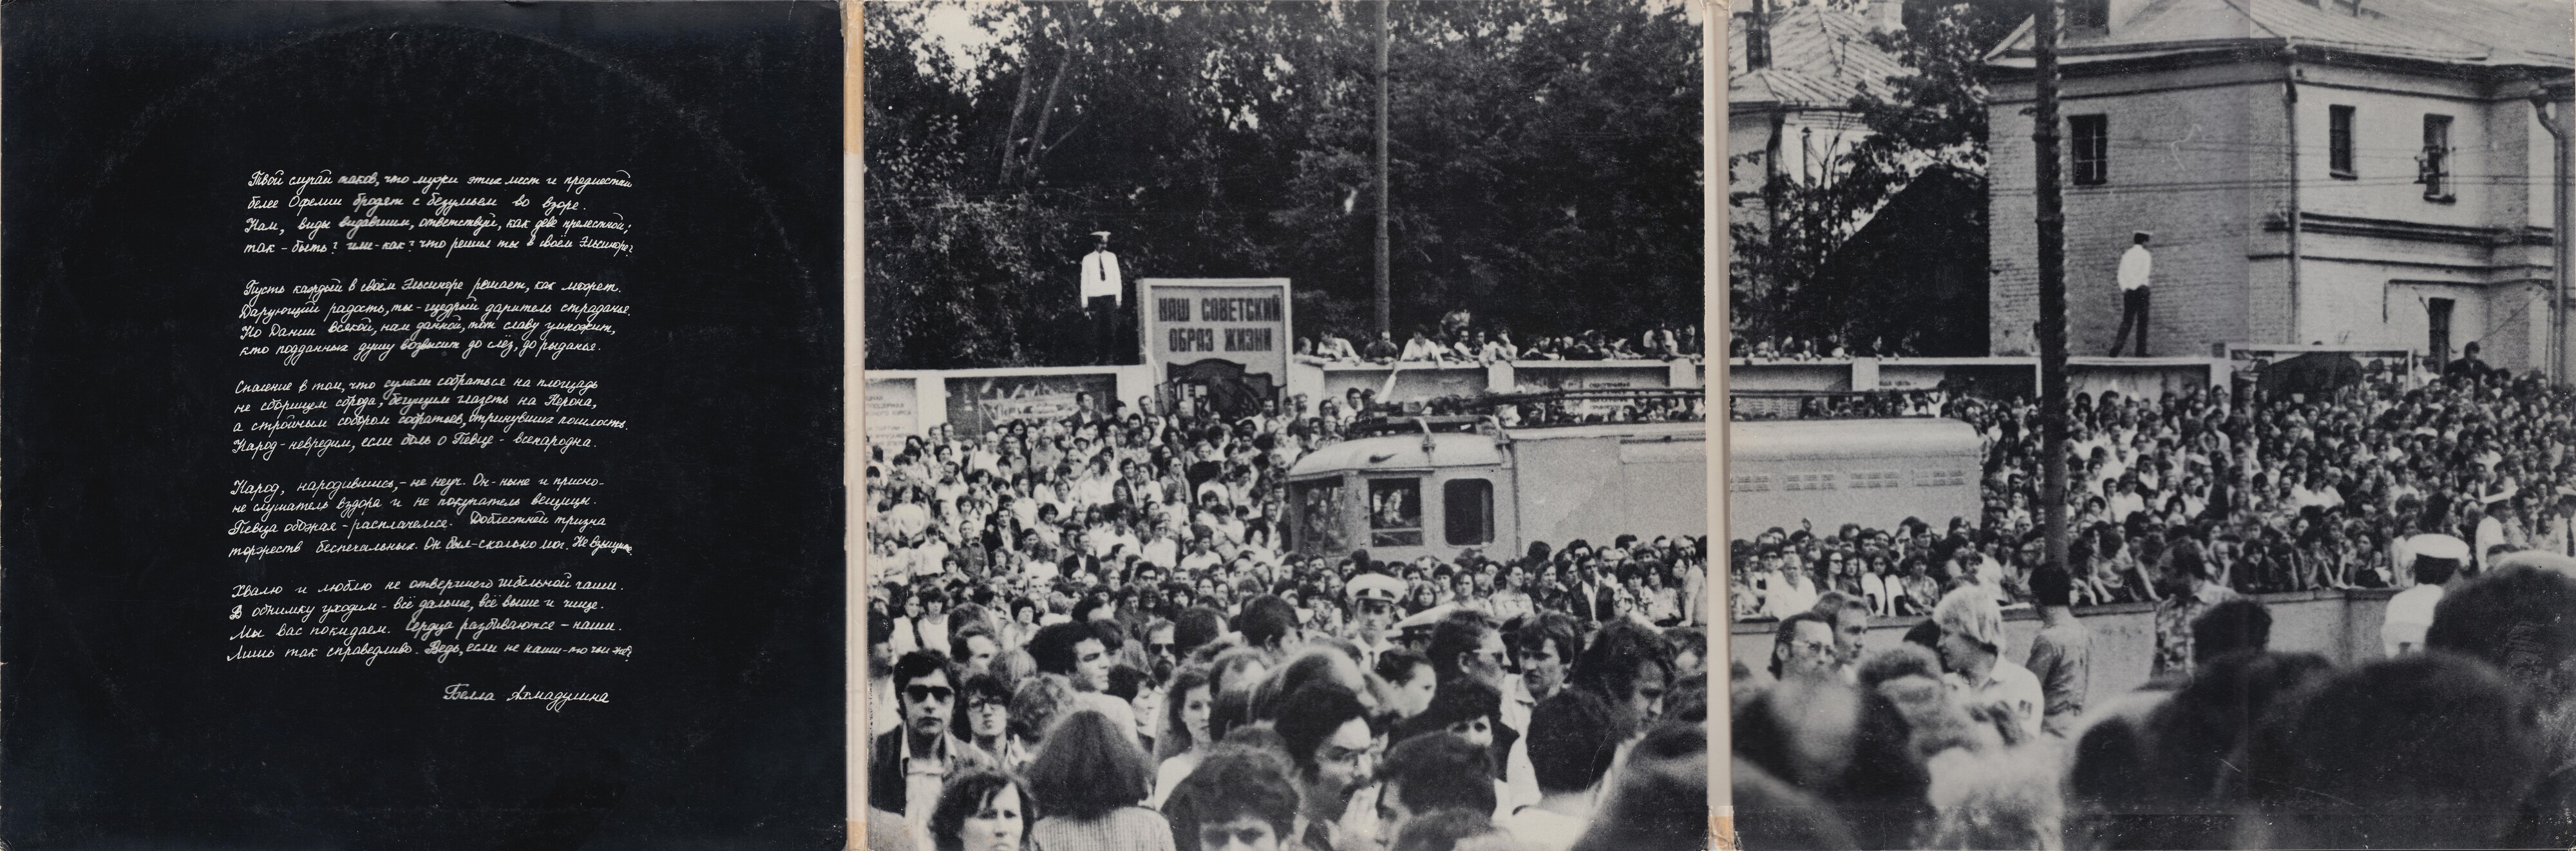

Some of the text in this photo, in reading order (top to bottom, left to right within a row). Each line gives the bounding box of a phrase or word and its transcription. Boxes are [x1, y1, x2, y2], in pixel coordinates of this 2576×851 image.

[247, 169, 285, 187] Твой
[289, 169, 333, 196] случай
[384, 175, 410, 184] что
[412, 175, 459, 195] мужи
[466, 176, 502, 186] этих
[504, 176, 540, 185] мест
[288, 195, 343, 216] Офелии
[352, 193, 404, 218] бродят
[426, 192, 498, 218] безумьем
[511, 194, 530, 207] во
[297, 216, 331, 240] виды
[506, 218, 531, 229] как
[530, 215, 558, 239] деве
[243, 242, 276, 254] так
[346, 241, 374, 251] или
[419, 240, 447, 249] что
[445, 237, 491, 258] решил
[497, 240, 520, 249] ты
[526, 233, 536, 247] в
[539, 234, 573, 248] своём
[243, 279, 285, 307] Пусть
[292, 278, 343, 306] каждый
[348, 278, 358, 292] в
[360, 278, 397, 292] своём
[401, 278, 464, 296] Эльсиноре
[534, 280, 556, 291] как
[238, 303, 321, 325] Дарующий
[390, 303, 413, 312] ты
[424, 296, 480, 322] щедрый
[479, 303, 552, 325] даритель
[1159, 294, 1280, 322] НАШ СОВЕТСКИЙ
[240, 325, 262, 340] Но
[268, 323, 317, 338] Дании
[380, 323, 410, 332] нам
[467, 319, 496, 329] тот
[502, 318, 540, 341] славу
[1169, 327, 1271, 352] ОБРАЗ ЖИЗНИ
[239, 346, 270, 357] кто
[275, 344, 349, 367] подданных
[353, 342, 395, 362] душу
[399, 336, 460, 358] возвысит
[461, 339, 482, 359] до
[518, 339, 537, 358] до
[298, 379, 308, 394] в
[348, 381, 376, 390] что
[383, 378, 431, 400] сумели
[437, 372, 506, 391] собраться
[513, 378, 531, 387] на
[536, 378, 598, 396] площадь
[234, 404, 251, 414] не
[260, 398, 328, 419] сборищем
[388, 392, 450, 416] бегущим
[457, 394, 511, 419] глазеть
[516, 396, 537, 406] на
[232, 422, 243, 432] а
[251, 414, 327, 438] стройным
[337, 410, 390, 432] собором
[468, 409, 554, 434] отринувших
[231, 438, 278, 461] Народ
[361, 437, 393, 447] если
[400, 433, 431, 445] боль
[437, 435, 448, 446] о
[451, 432, 494, 449] Певце
[410, 478, 427, 487] не
[498, 478, 531, 486] ныне
[232, 504, 247, 513] не
[252, 501, 329, 522] слушатель
[336, 497, 383, 519] вздора
[390, 498, 402, 508] и
[413, 497, 430, 507] не
[437, 497, 520, 516] покупатель
[227, 519, 279, 539] Певца
[283, 519, 337, 534] обожая
[554, 515, 607, 533] тризна
[228, 540, 303, 563] торжеств
[572, 535, 589, 548] Не
[231, 584, 283, 598] Хвалю
[317, 579, 372, 593] люблю
[384, 580, 401, 590] не
[498, 572, 572, 588] гибельной
[229, 604, 243, 620] В
[251, 603, 316, 623] обнимку
[318, 602, 377, 624] уходим
[393, 595, 416, 609] всё
[478, 593, 502, 608] всё
[501, 594, 540, 607] выше
[544, 599, 555, 607] и
[229, 625, 265, 641] Мы
[276, 623, 303, 636] вас
[405, 615, 455, 642] Сердца
[455, 617, 555, 640] разбиваются
[227, 644, 275, 662] Лишь
[284, 647, 318, 658] так
[466, 643, 498, 653] если
[504, 644, 520, 652] не
[591, 645, 611, 654] чьи
[442, 683, 610, 713] Белла Ахмадулина
